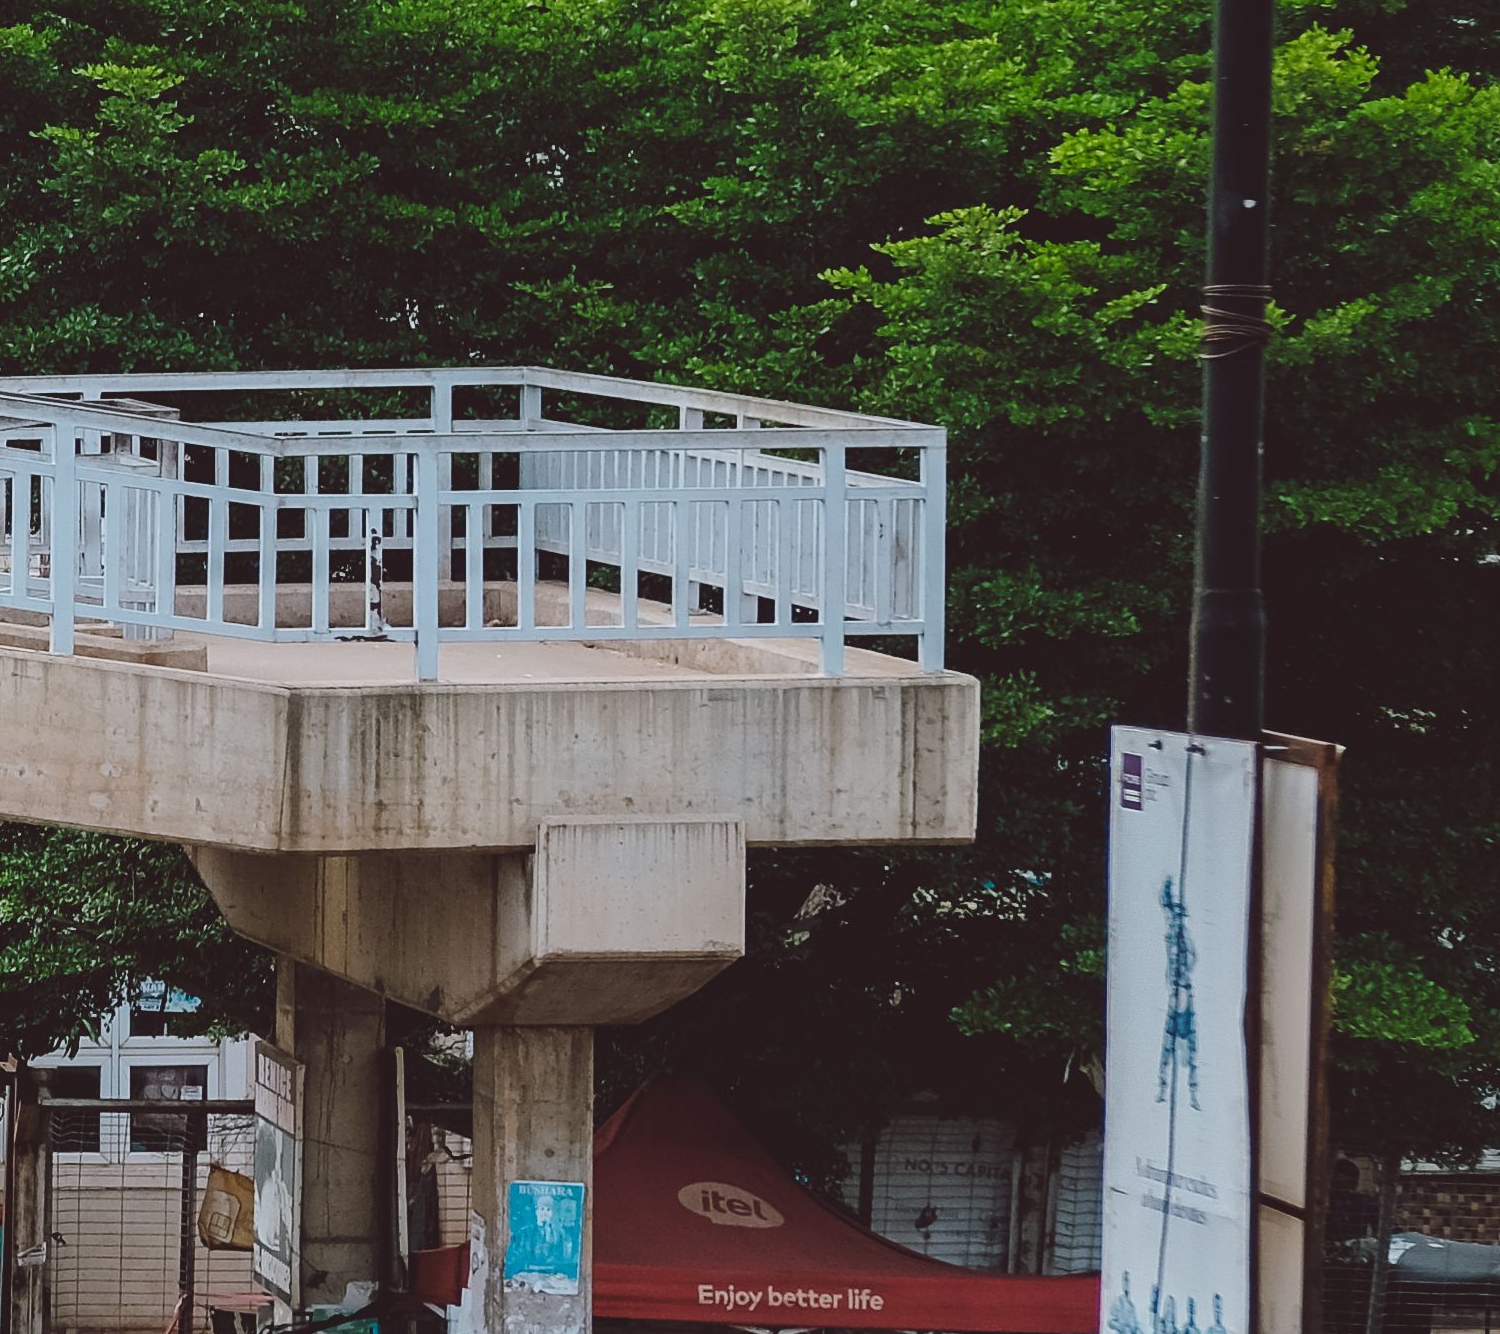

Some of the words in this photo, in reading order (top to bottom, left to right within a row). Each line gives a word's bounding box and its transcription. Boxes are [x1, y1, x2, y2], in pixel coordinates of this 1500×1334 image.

[702, 1189, 768, 1221] itel
[698, 1284, 763, 1311] Enjoy
[768, 1285, 842, 1310] better
[848, 1288, 884, 1311] life
